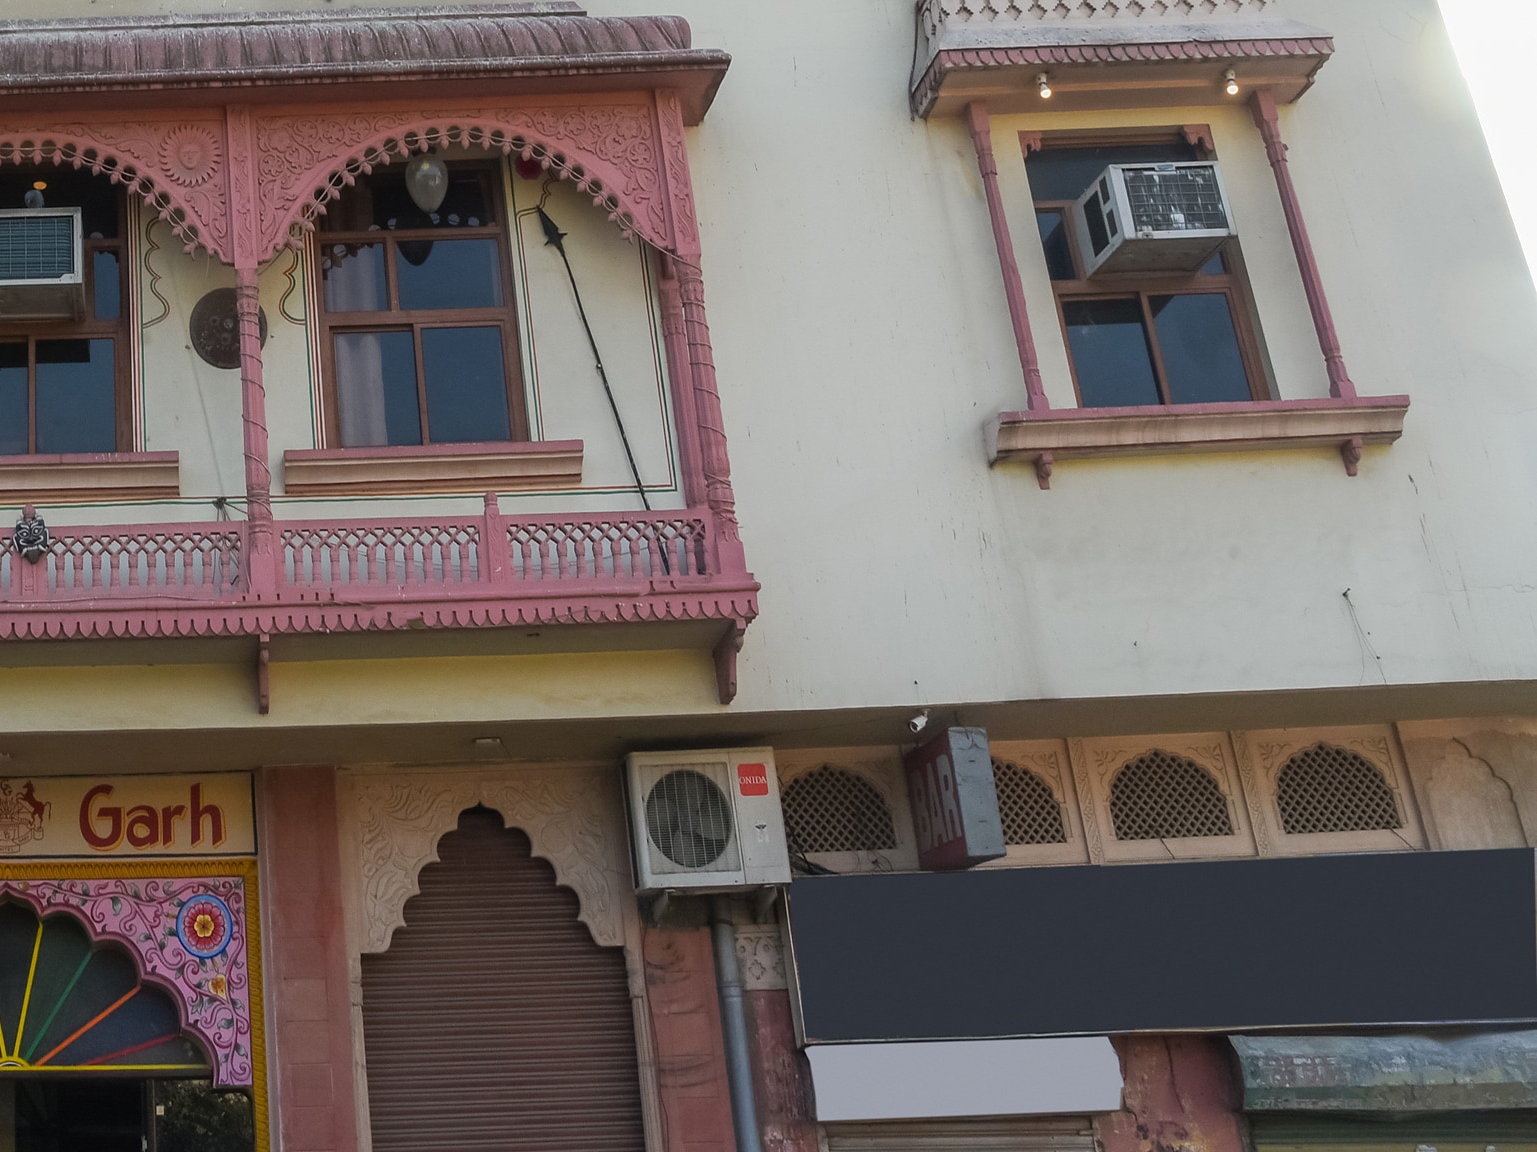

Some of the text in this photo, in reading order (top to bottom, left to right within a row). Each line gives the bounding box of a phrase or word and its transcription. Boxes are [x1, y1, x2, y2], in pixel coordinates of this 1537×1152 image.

[739, 775, 767, 785] ONIDA
[909, 753, 962, 852] BAR
[79, 783, 227, 852] Garh
